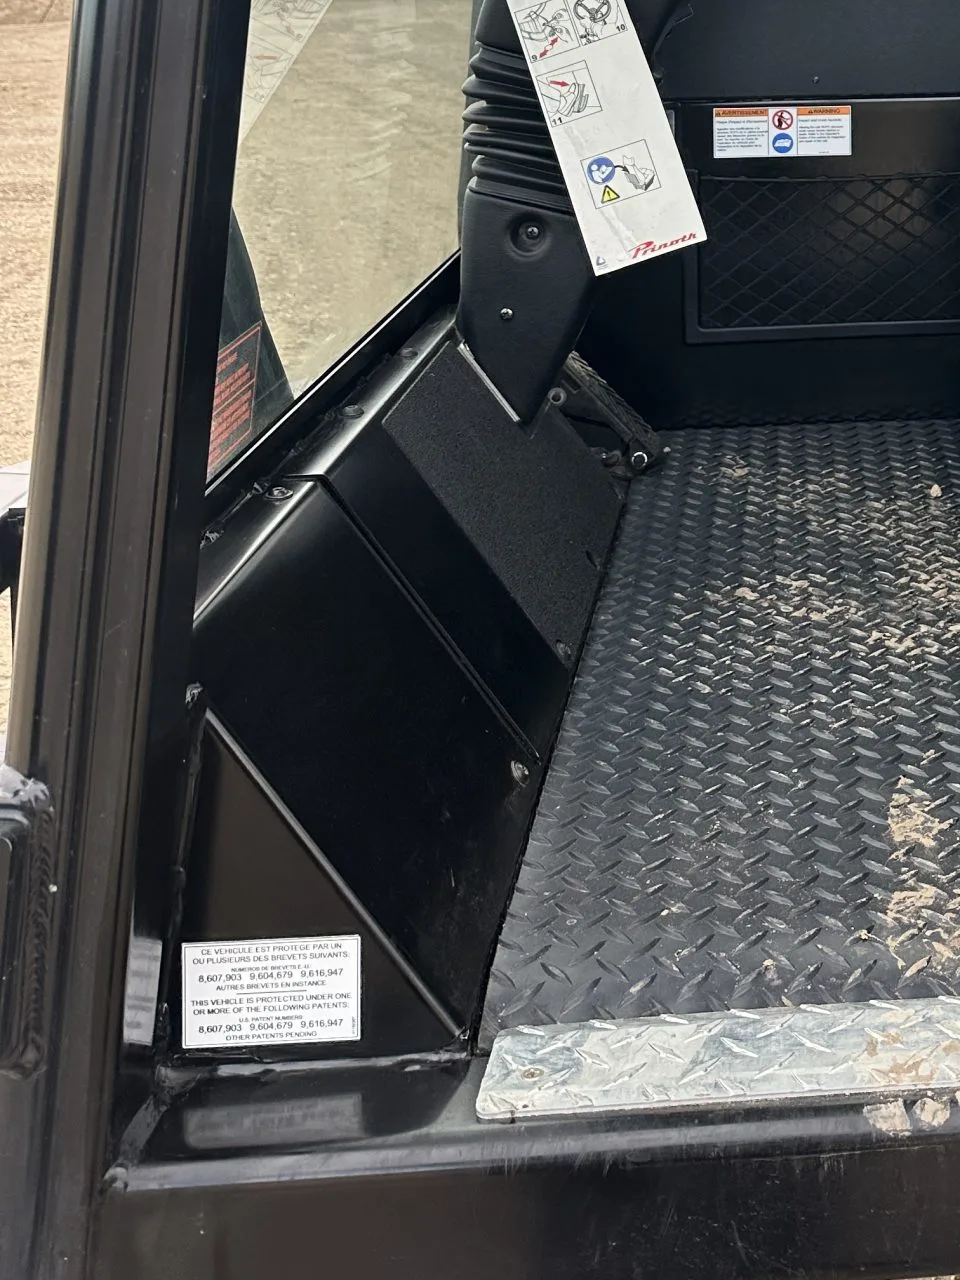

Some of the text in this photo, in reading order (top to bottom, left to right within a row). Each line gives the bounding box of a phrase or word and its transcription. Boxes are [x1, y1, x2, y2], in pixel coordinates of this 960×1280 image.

[616, 24, 626, 32] 10
[532, 54, 538, 62] 9
[552, 116, 563, 125] 11
[628, 232, 697, 259] Prinoth
[201, 948, 213, 956] CE
[312, 942, 328, 950] PAR
[330, 942, 342, 950] UN
[206, 956, 250, 964] PLUSIEURS
[252, 954, 269, 962] DES
[271, 952, 308, 960] BREVETS
[198, 968, 344, 984] 8,607,903 9,604,679 9,616,947
[216, 983, 245, 991] AUTRES
[246, 982, 278, 990] BREVETS
[210, 998, 244, 1006] VEHICLE
[256, 994, 304, 1003] PROTECTED
[335, 992, 351, 1000] ONE
[192, 1008, 206, 1016] OR
[207, 1007, 231, 1015] MORE
[232, 1006, 244, 1014] OF
[264, 1003, 310, 1012] FOLLOWING
[312, 1002, 350, 1010] PATENTS:
[198, 1024, 242, 1034] 8,607,903
[250, 1021, 293, 1032] 9,604,679
[300, 1018, 344, 1029] 9,616,947
[252, 1032, 284, 1040] PATENTS
[286, 1030, 317, 1038] PENDING
